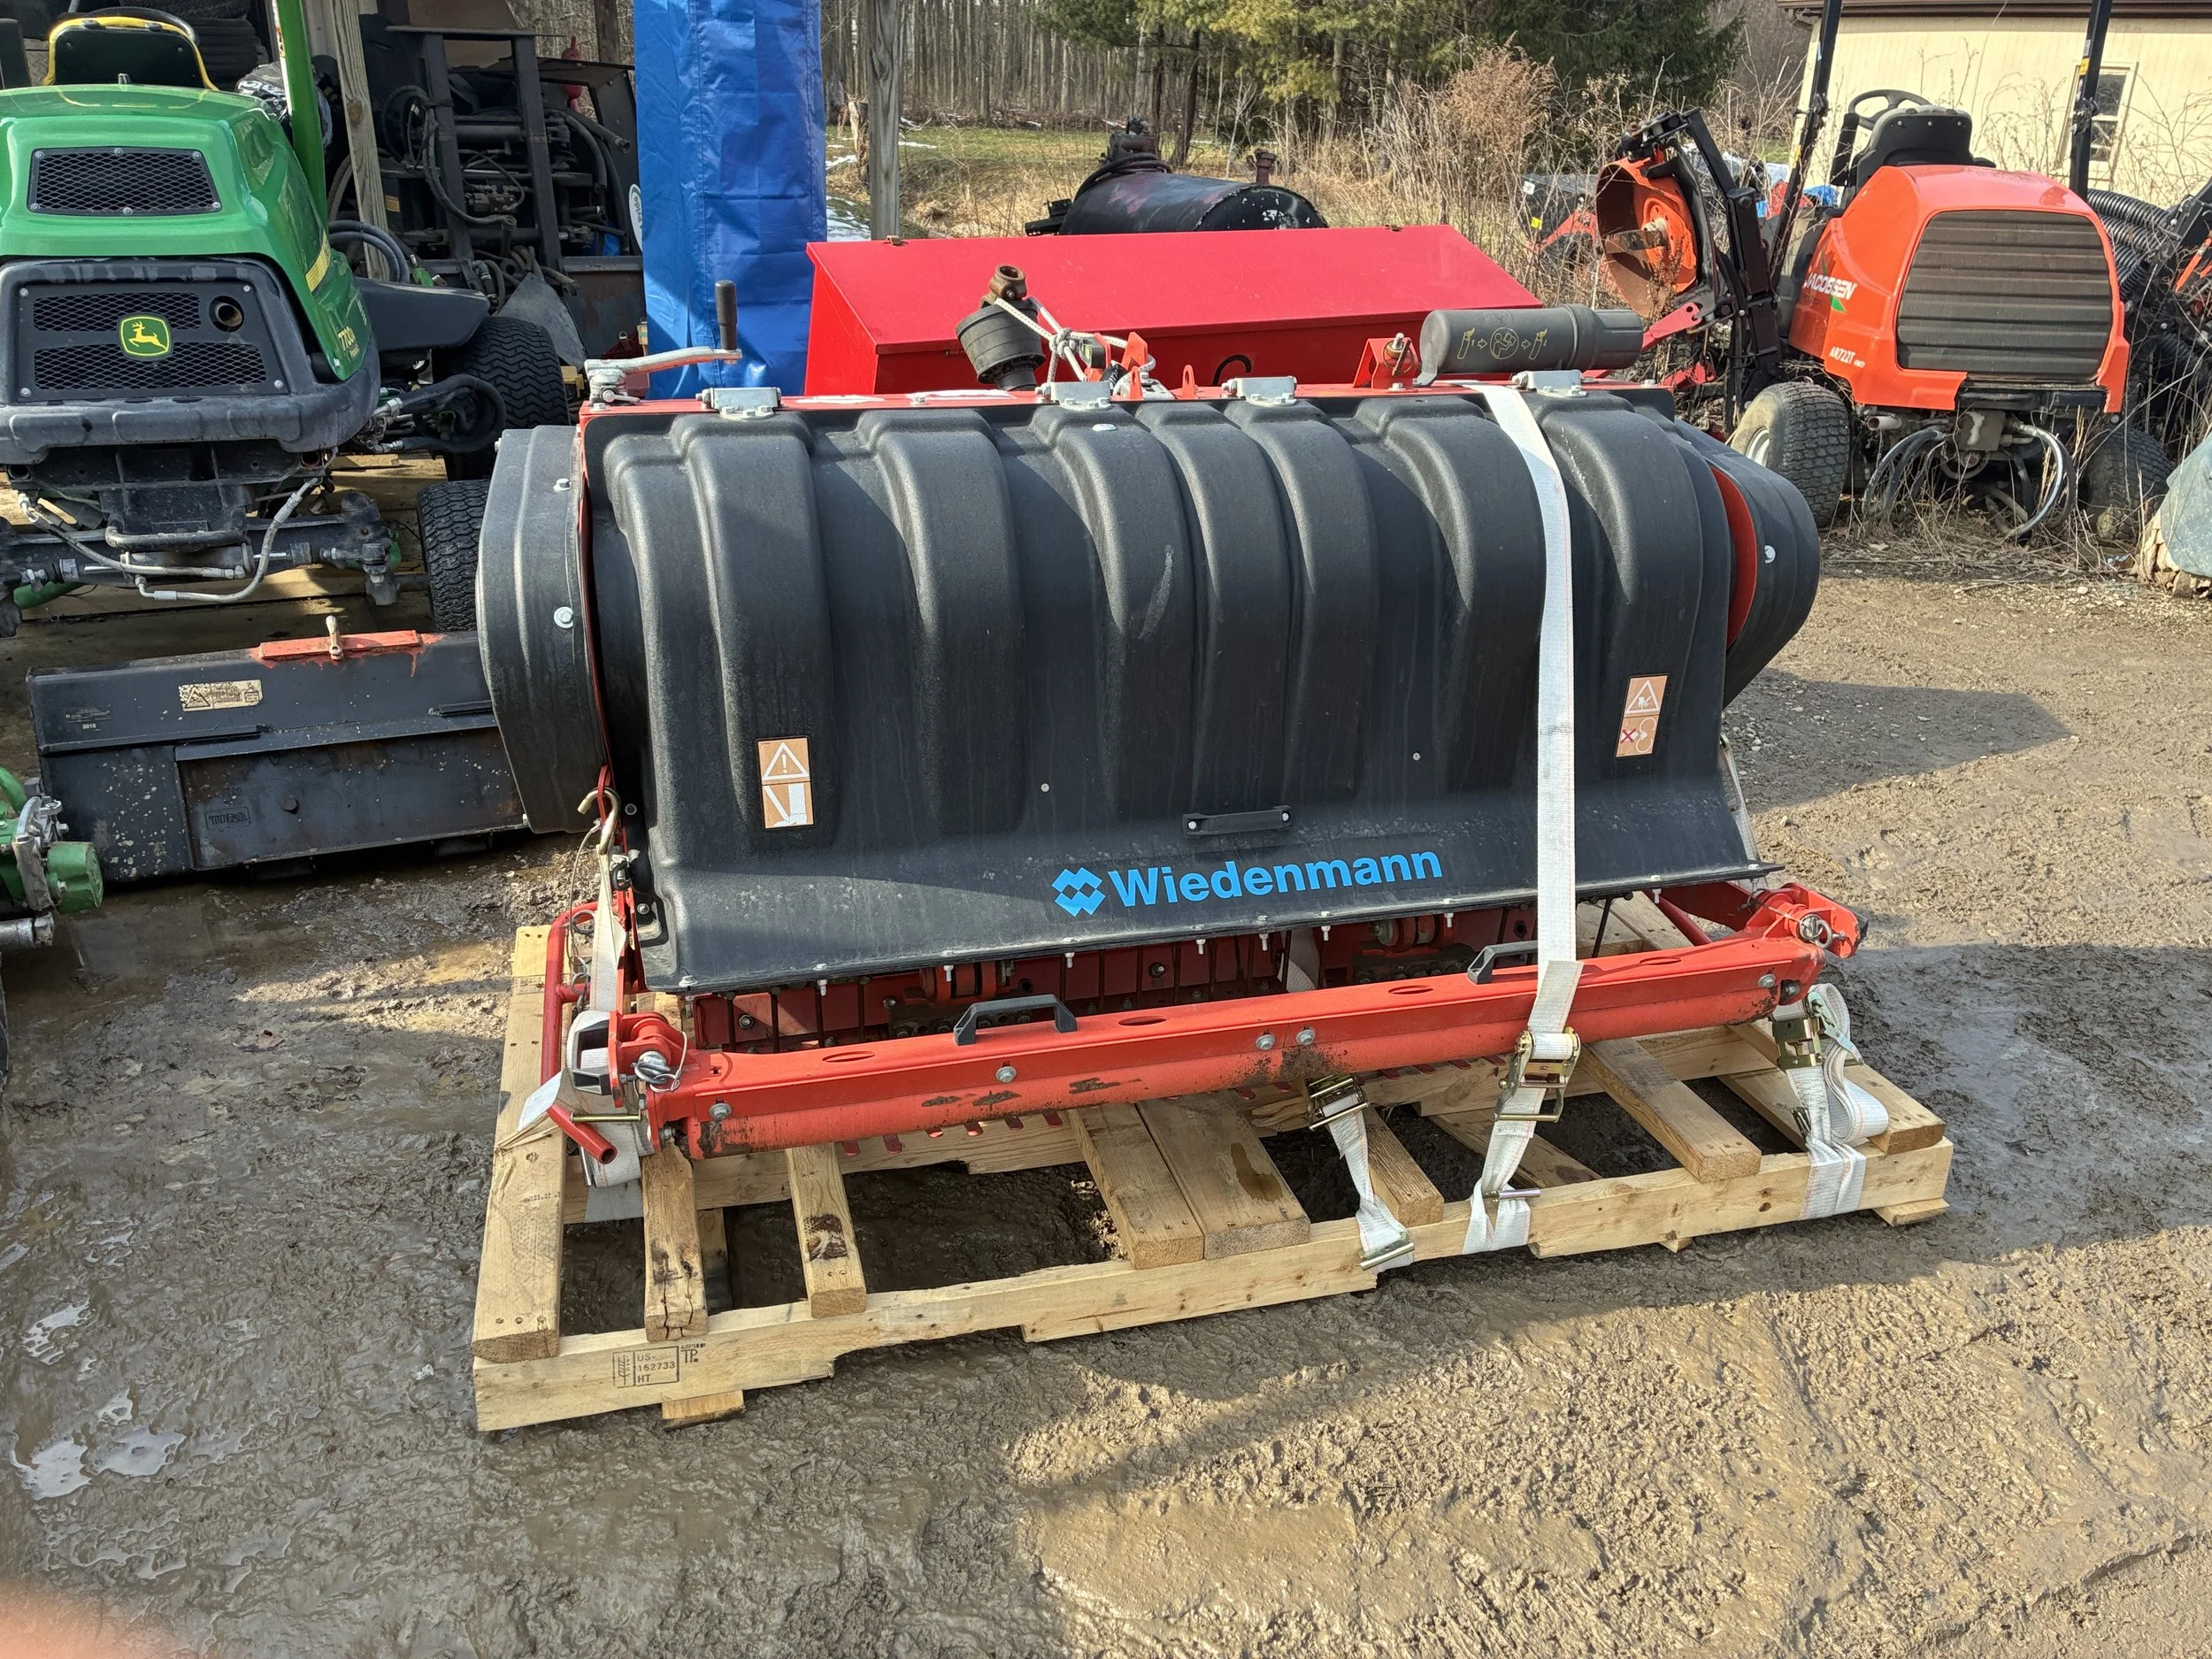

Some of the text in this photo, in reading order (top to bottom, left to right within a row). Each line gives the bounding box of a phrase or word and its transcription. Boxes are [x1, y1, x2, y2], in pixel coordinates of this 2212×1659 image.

[1802, 273, 1858, 300] JACOBSEN
[1828, 345, 1856, 365] AR722T
[1107, 850, 1444, 908] Wiedenmann
[637, 1361, 676, 1372] 162733
[637, 1374, 651, 1383] HT
